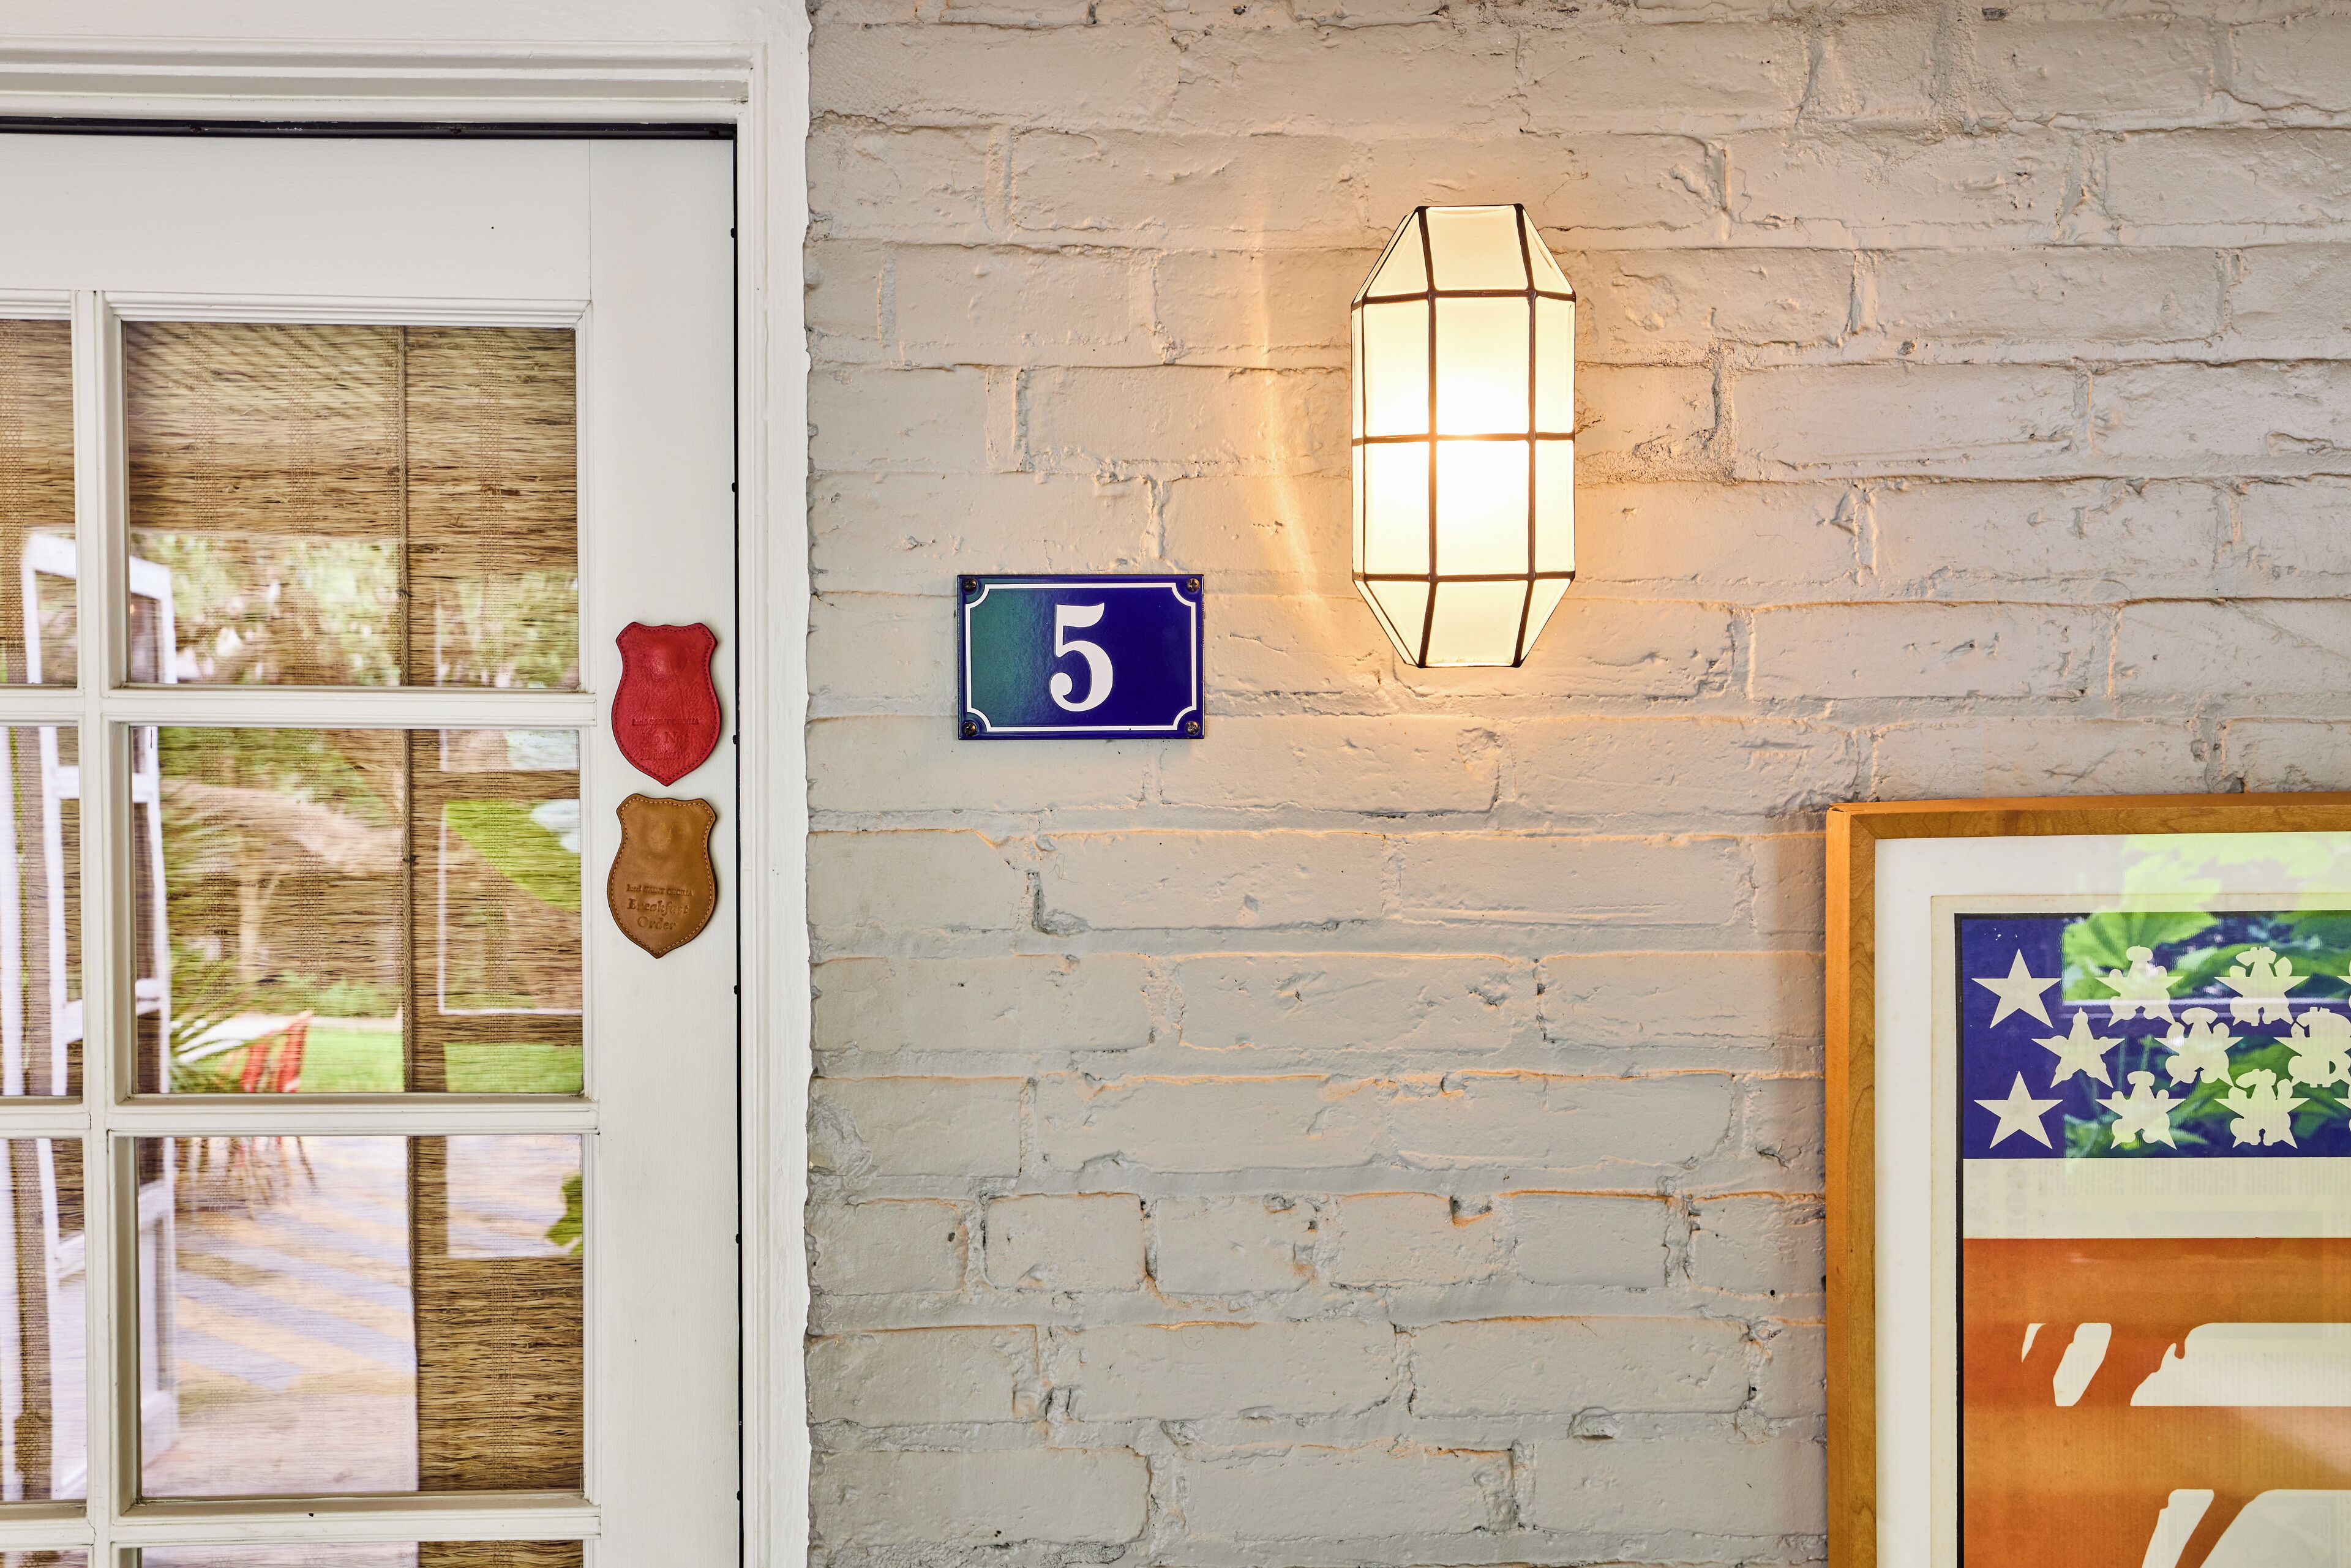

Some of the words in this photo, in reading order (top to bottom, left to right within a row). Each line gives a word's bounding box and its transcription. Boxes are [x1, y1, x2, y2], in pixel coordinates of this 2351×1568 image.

[1050, 602, 1113, 712] 5
[626, 898, 689, 917] Breakfast
[637, 916, 677, 930] Order
